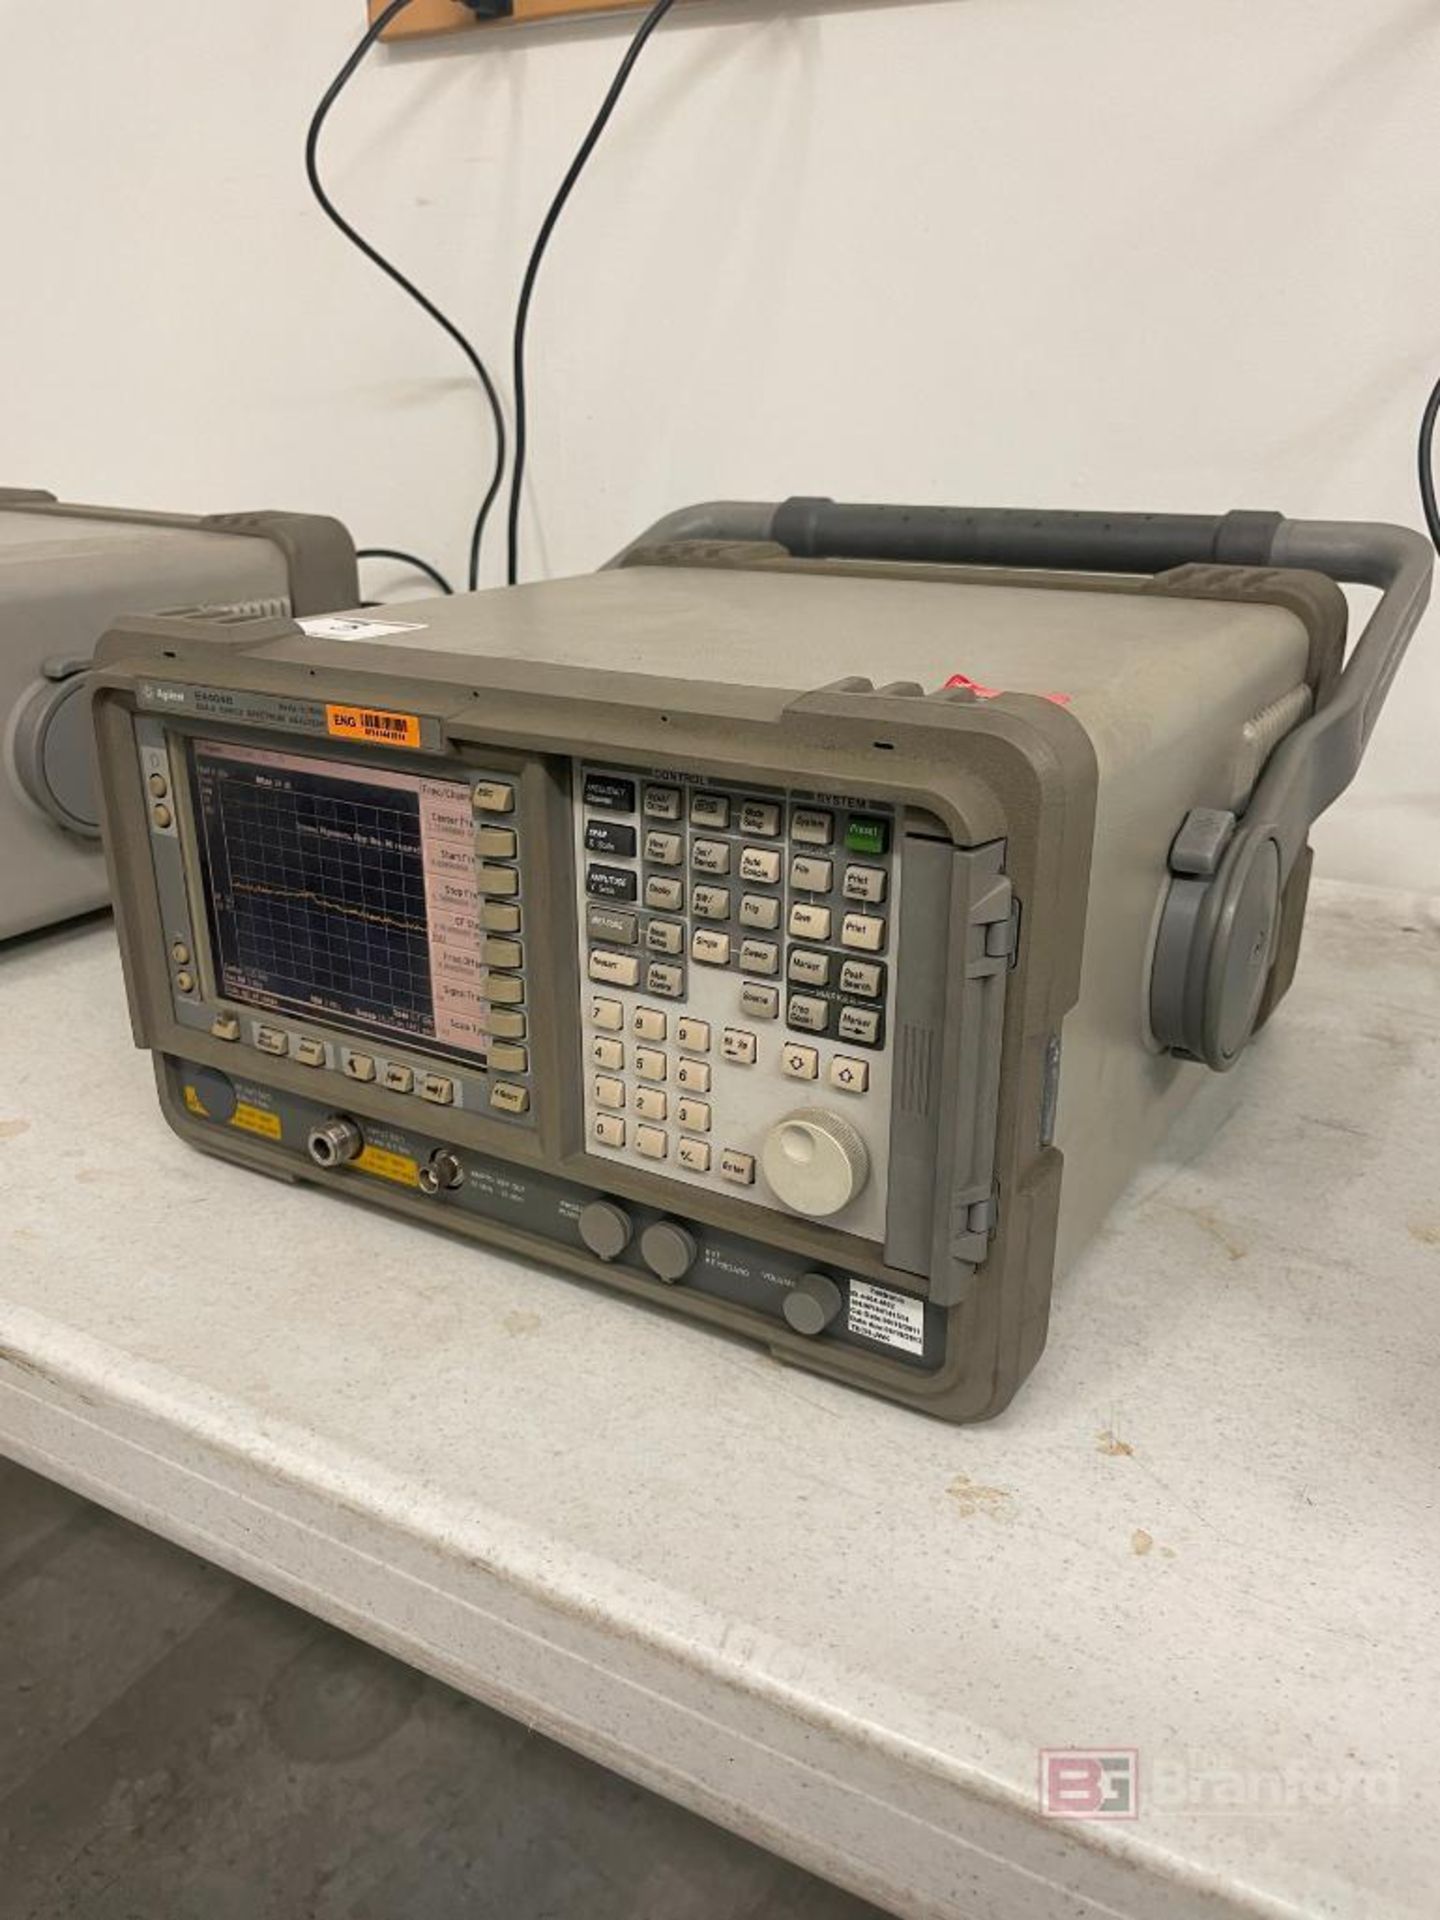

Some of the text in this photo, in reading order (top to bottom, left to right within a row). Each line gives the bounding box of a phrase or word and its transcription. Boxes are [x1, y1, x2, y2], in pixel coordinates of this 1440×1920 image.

[334, 714, 357, 728] ENG
[655, 769, 705, 786] CONTROL
[818, 792, 867, 808] SYSTEM
[850, 822, 878, 837] Preset
[847, 873, 868, 885] Print
[744, 902, 760, 915] Trig
[845, 921, 867, 934] Print
[695, 935, 718, 950] Single
[743, 947, 768, 961] Sweep
[793, 957, 820, 972] Marker
[844, 967, 864, 980] Peak
[843, 980, 872, 992] Search
[593, 1007, 601, 1018] 7
[635, 1018, 643, 1029] 8
[842, 1013, 871, 1028] Marker
[679, 1029, 687, 1041] 9
[594, 1046, 602, 1059] 4
[636, 1057, 644, 1070] 5
[679, 1069, 687, 1082] 6
[636, 1097, 645, 1109] 2
[679, 1108, 687, 1121] 3
[596, 1123, 604, 1135] 0
[722, 1159, 746, 1175] Enter
